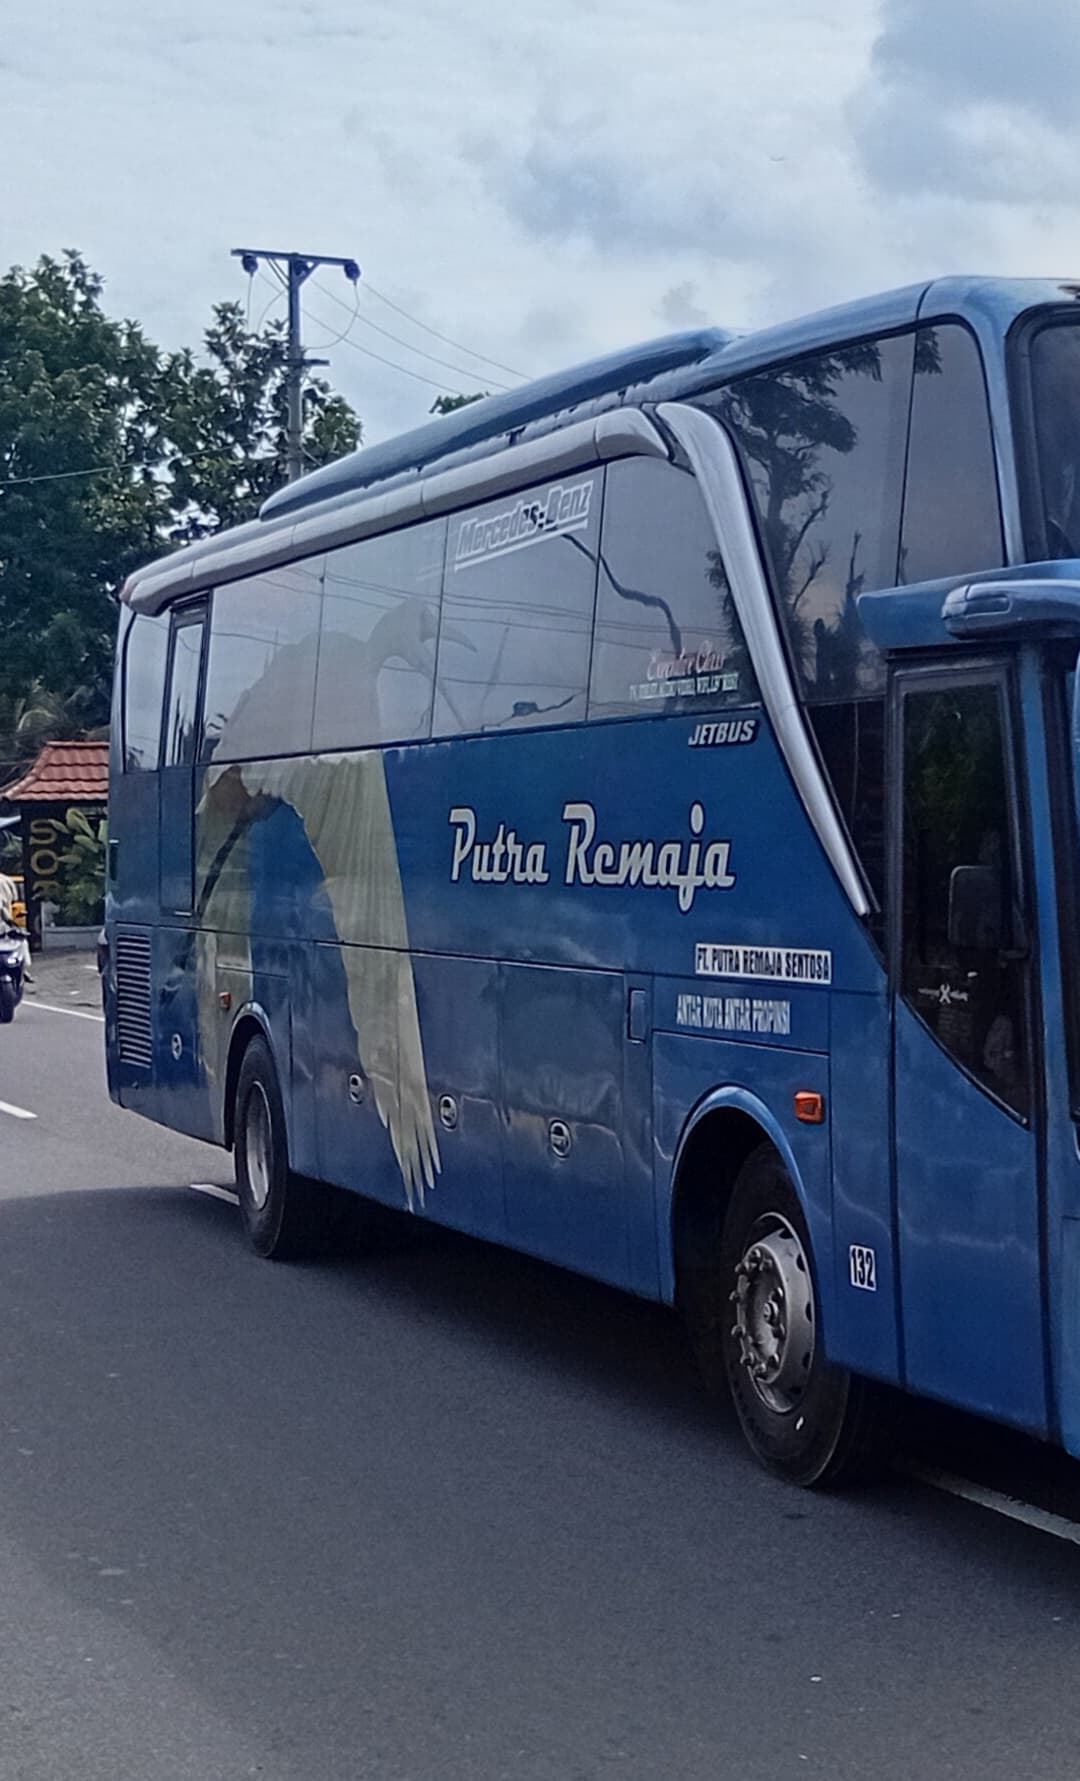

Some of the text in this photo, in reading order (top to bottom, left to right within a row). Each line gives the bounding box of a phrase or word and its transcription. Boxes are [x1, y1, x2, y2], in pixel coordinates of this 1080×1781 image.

[456, 480, 594, 560] Mercedes-Benz
[687, 719, 756, 747] JETBUS
[448, 801, 736, 914] Putra Remaja
[712, 948, 740, 974] PUTRA
[743, 950, 783, 977] REMAJA
[785, 952, 830, 981] SENTOSA
[677, 993, 702, 1028] ANTAR
[724, 997, 751, 1032] ANTAR
[850, 1246, 875, 1288] 132
